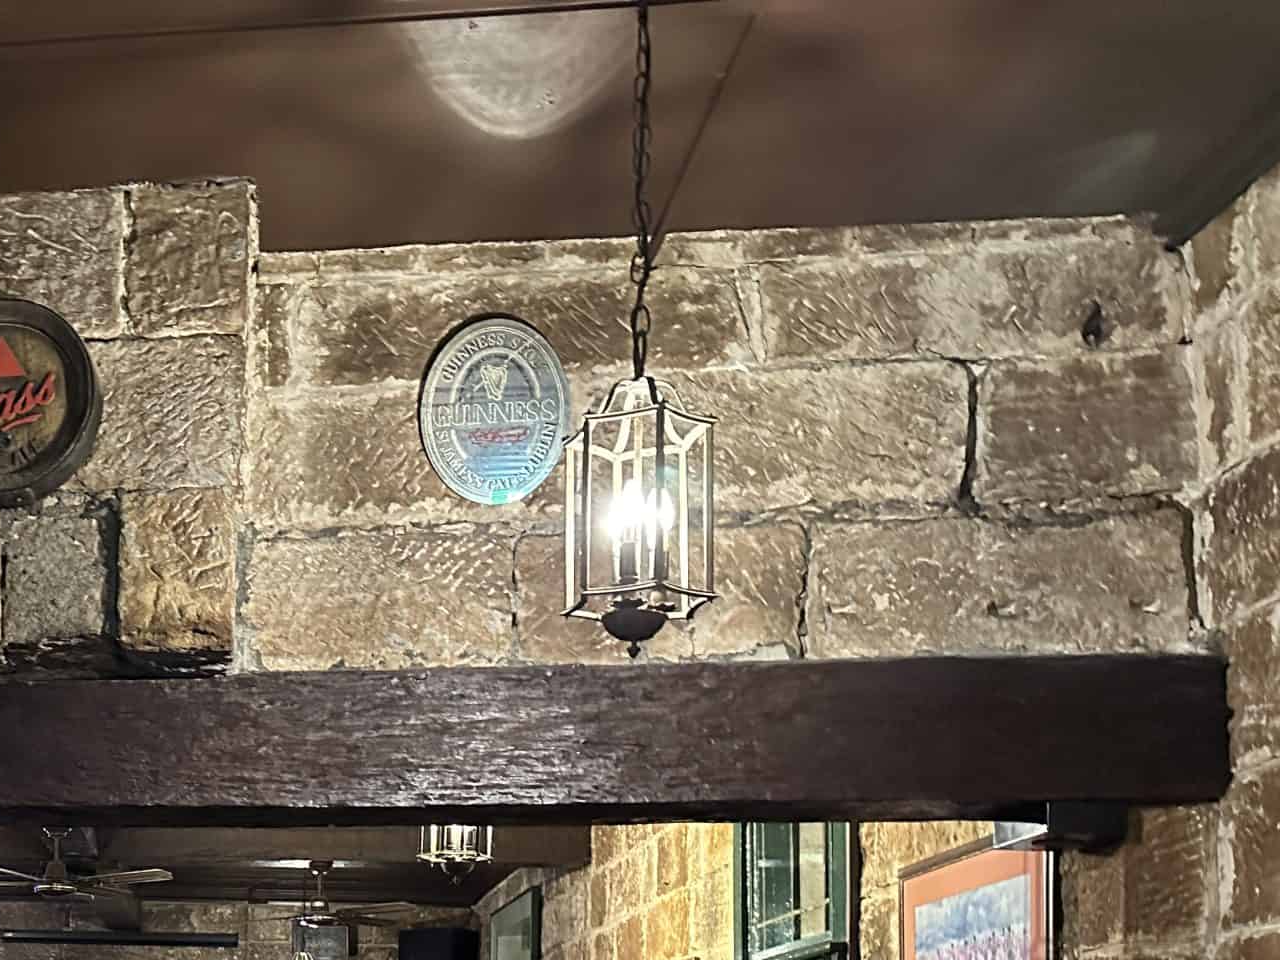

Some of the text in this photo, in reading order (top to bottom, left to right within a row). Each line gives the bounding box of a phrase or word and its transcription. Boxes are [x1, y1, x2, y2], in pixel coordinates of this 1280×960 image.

[441, 333, 506, 382] GUINNESS
[433, 399, 557, 427] GUINNESS
[520, 421, 557, 475] DUBLIN
